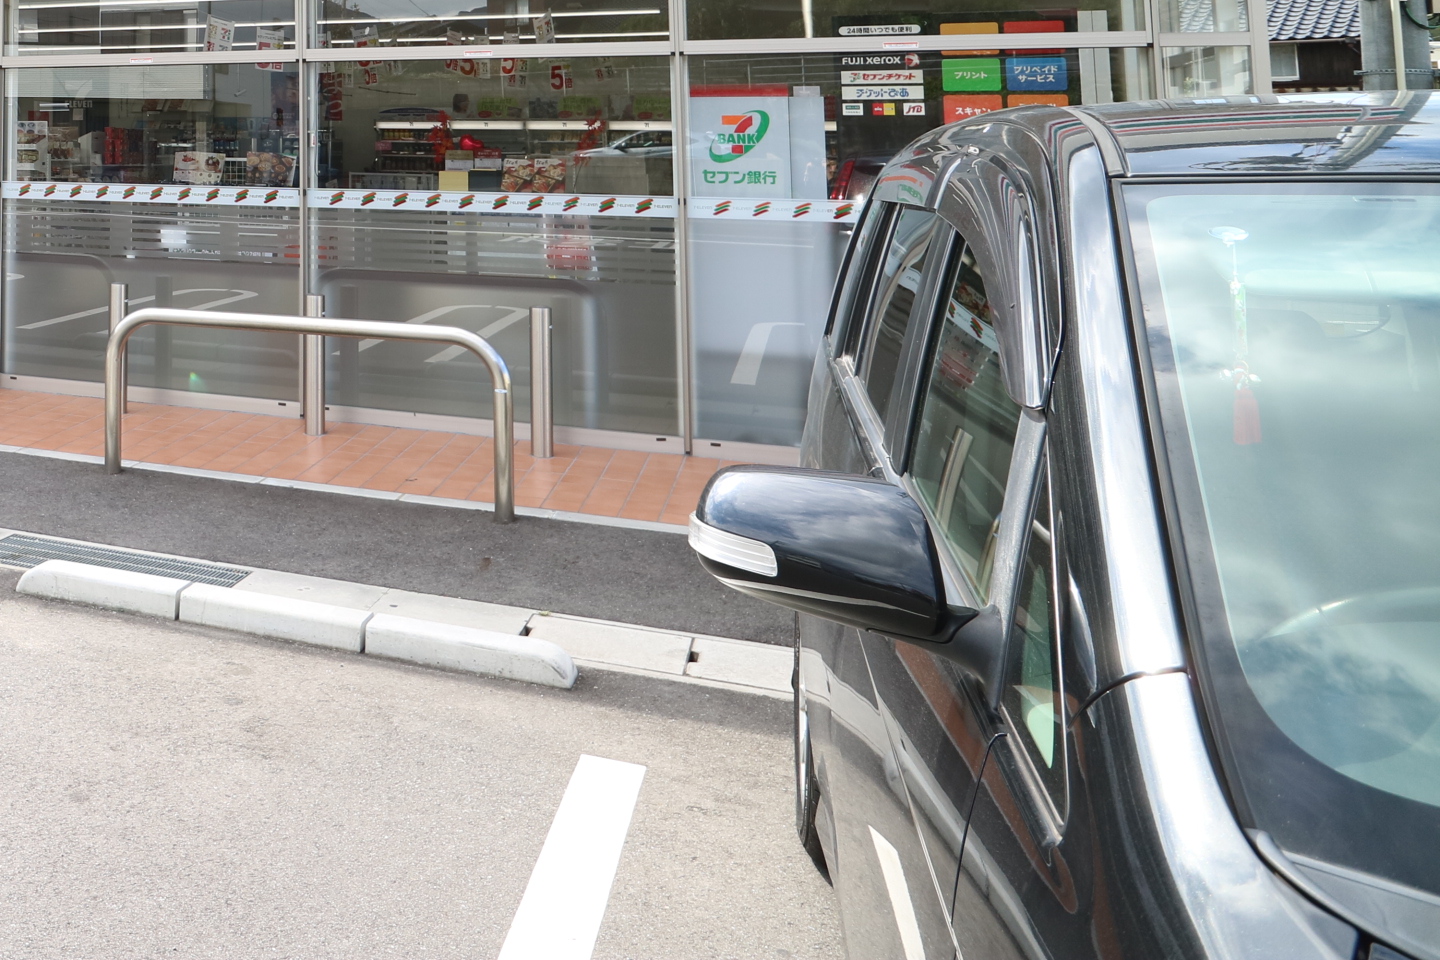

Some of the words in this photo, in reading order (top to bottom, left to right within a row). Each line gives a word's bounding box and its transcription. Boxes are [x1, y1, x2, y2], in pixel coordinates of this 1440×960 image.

[846, 26, 913, 34] 24時間いつでも便利
[842, 57, 864, 65] FUJI
[866, 56, 901, 65] xerox
[1013, 65, 1058, 75] プリペイド
[862, 73, 916, 81] セブンチケット
[954, 71, 988, 79] プリント
[1018, 74, 1056, 83] サービス
[856, 88, 909, 98] チケットぴあ
[905, 105, 923, 114] JTB
[717, 133, 758, 145] BANK
[721, 115, 753, 154] 7
[702, 169, 777, 185] セブン銀行
